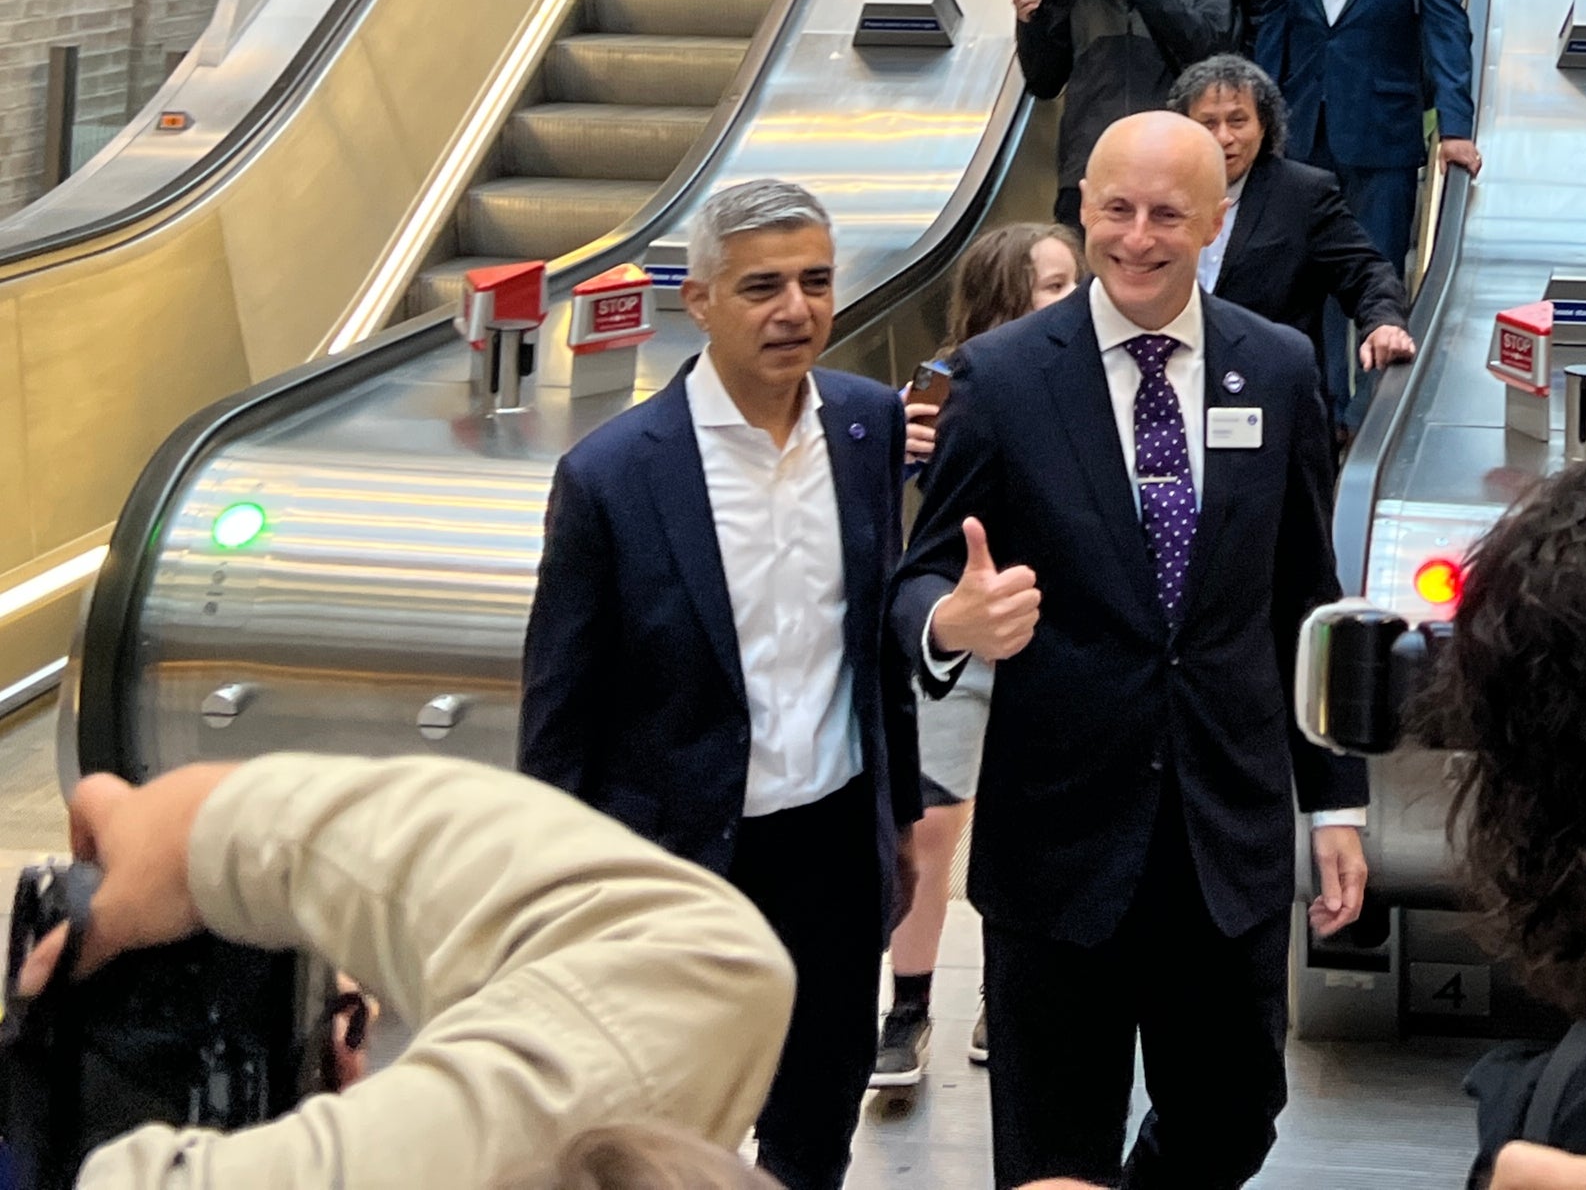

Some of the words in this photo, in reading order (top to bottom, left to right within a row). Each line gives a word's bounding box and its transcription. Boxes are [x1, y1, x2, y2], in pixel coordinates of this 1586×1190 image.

[598, 295, 640, 315] STOP
[1503, 332, 1532, 352] STOP
[1432, 971, 1467, 1008] 4
